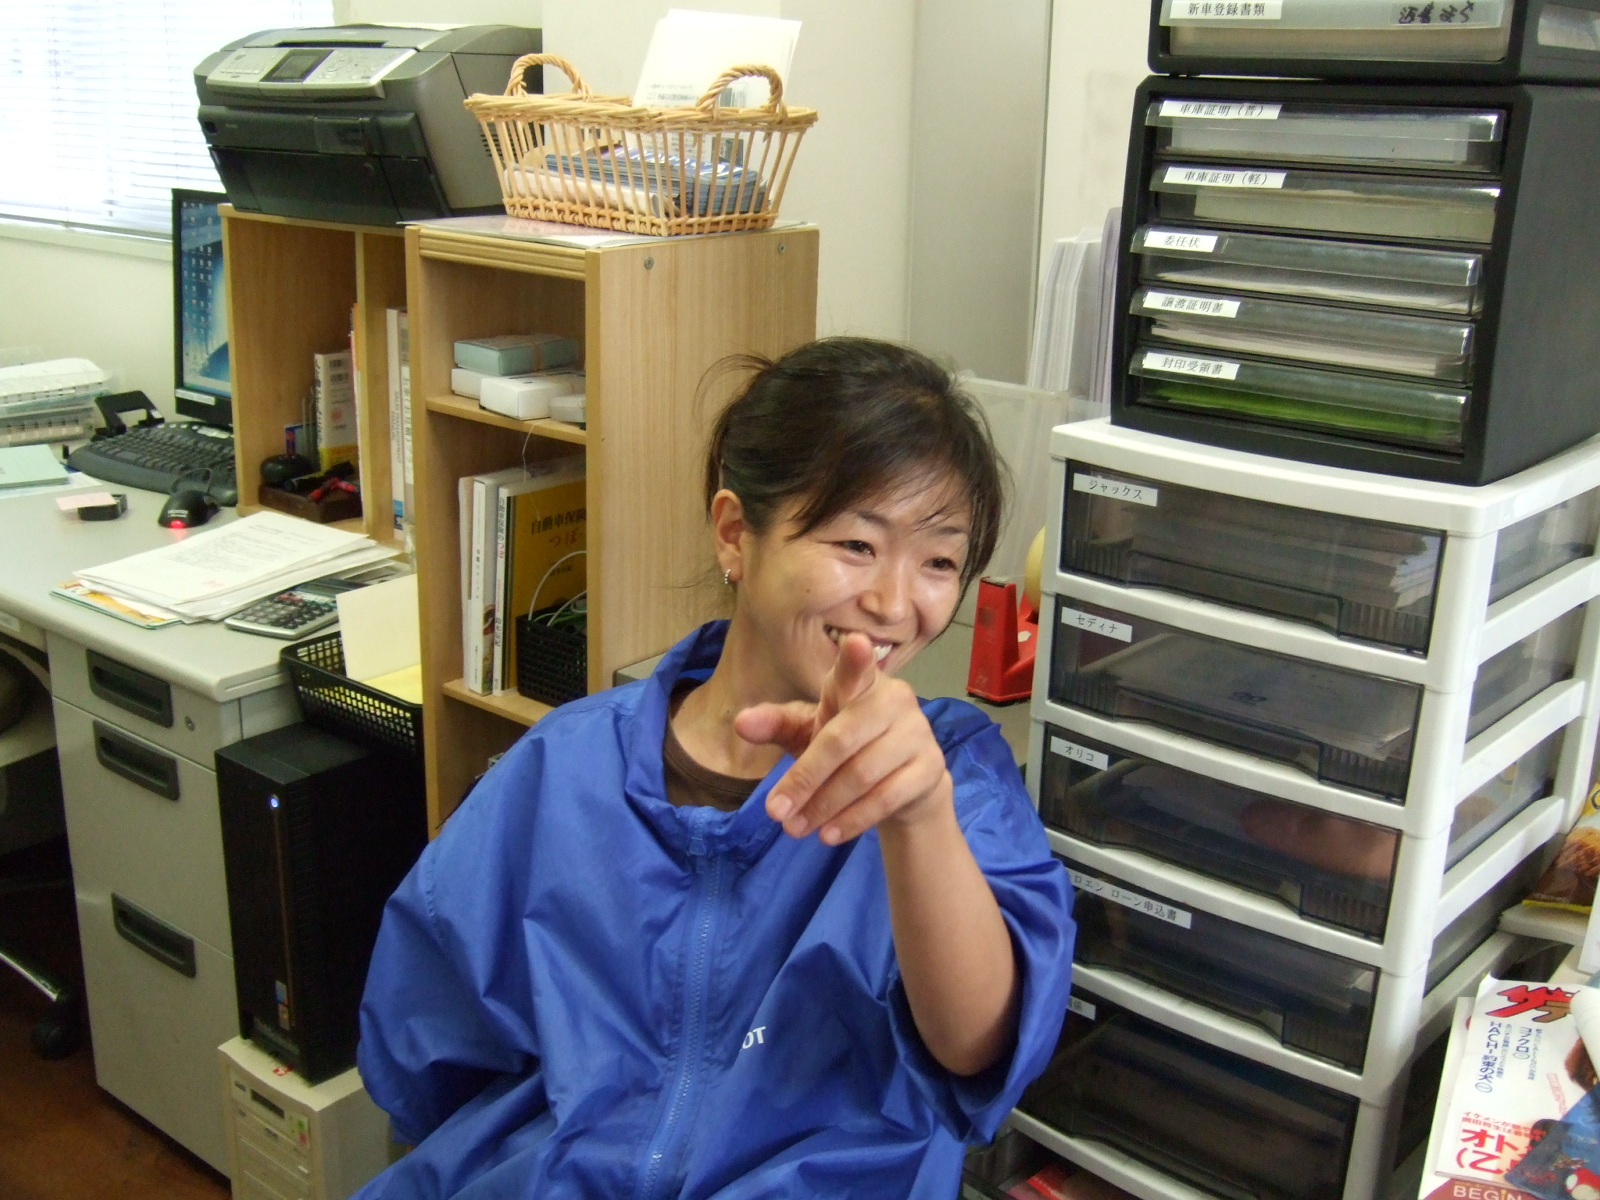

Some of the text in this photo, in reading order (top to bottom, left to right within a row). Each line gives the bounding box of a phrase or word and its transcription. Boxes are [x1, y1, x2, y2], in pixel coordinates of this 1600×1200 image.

[1188, 2, 1265, 16] 新車登録書類
[1164, 235, 1200, 248] 委任状
[1089, 479, 1142, 500] ジャックス
[1076, 614, 1118, 634] セディナ
[1065, 745, 1094, 762] オリコ
[1074, 874, 1104, 892] ロエン
[1461, 1128, 1532, 1158] オト
